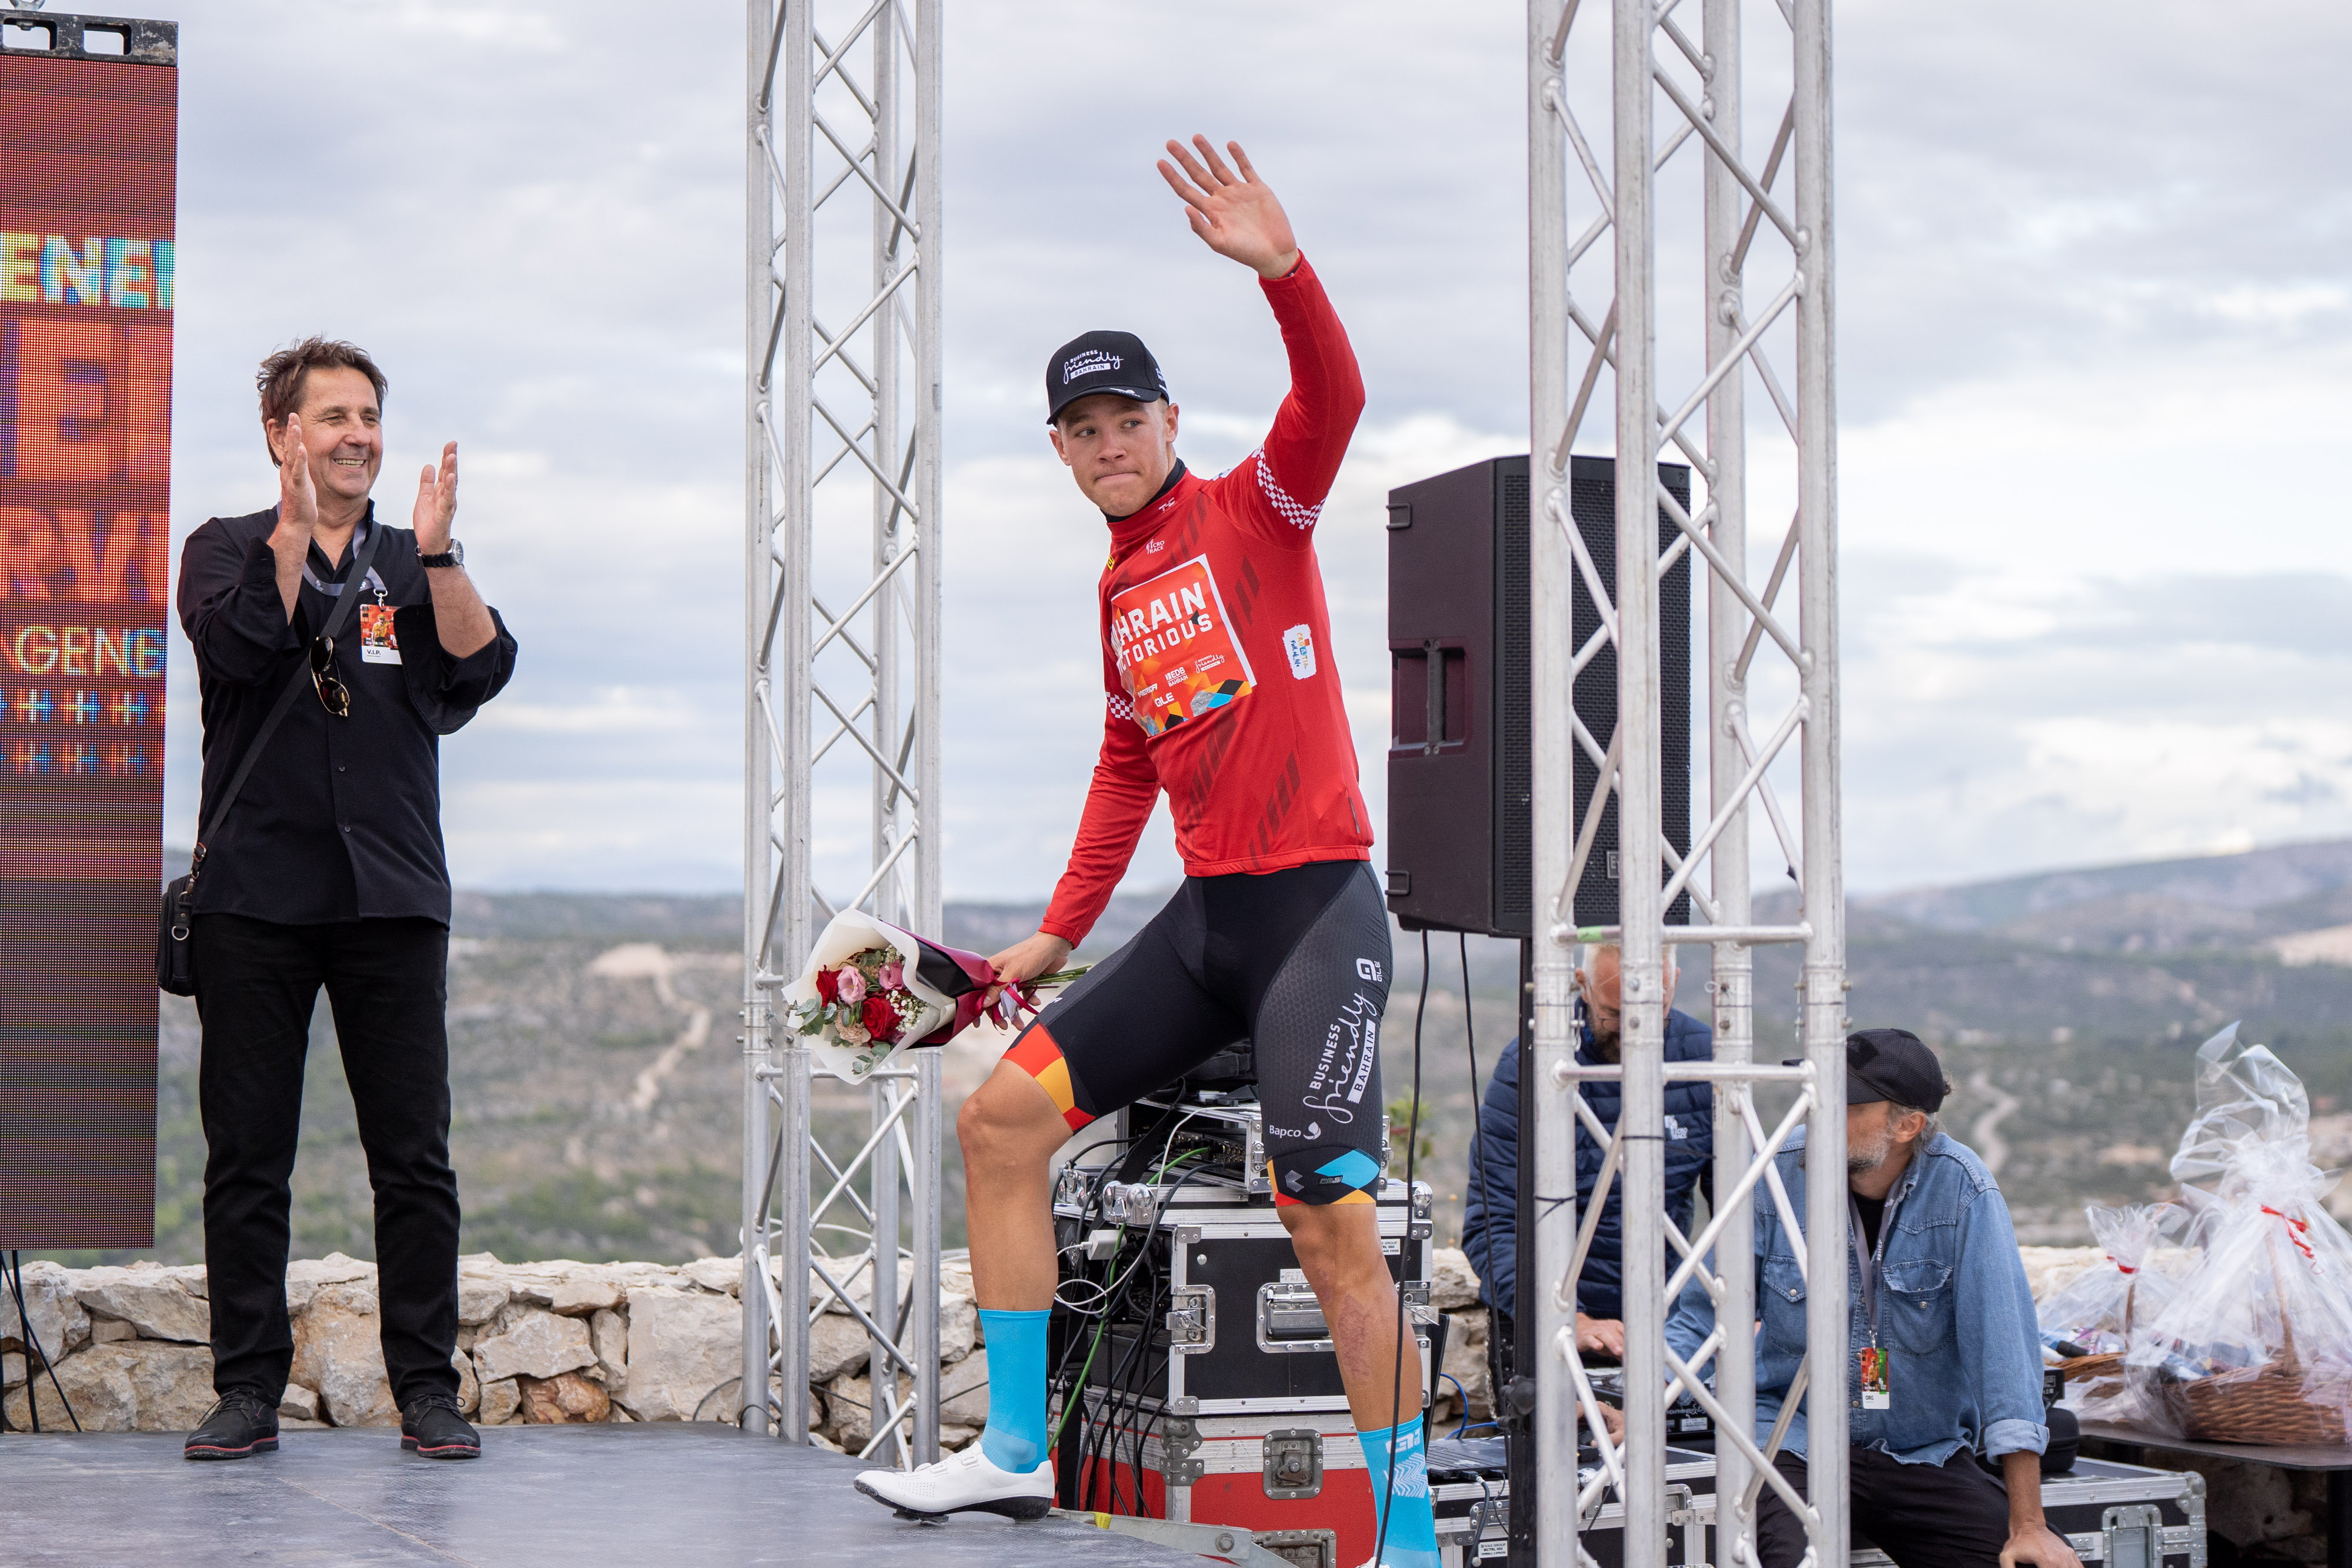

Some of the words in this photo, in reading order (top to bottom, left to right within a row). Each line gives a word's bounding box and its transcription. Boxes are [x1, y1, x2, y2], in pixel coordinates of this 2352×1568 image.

[1070, 350, 1098, 363] BUSINESS
[1063, 351, 1124, 385] friendly
[1074, 365, 1105, 376] BAHRAIN
[1149, 546, 1164, 554] RACE
[1194, 654, 1225, 674] friendly
[1168, 674, 1188, 687] BAHRAIN
[1303, 988, 1377, 1124] friendly
[1309, 1023, 1341, 1089] BUSINESS
[1354, 1029, 1375, 1092] BAHRAIN
[1269, 1124, 1302, 1138] Bapco
